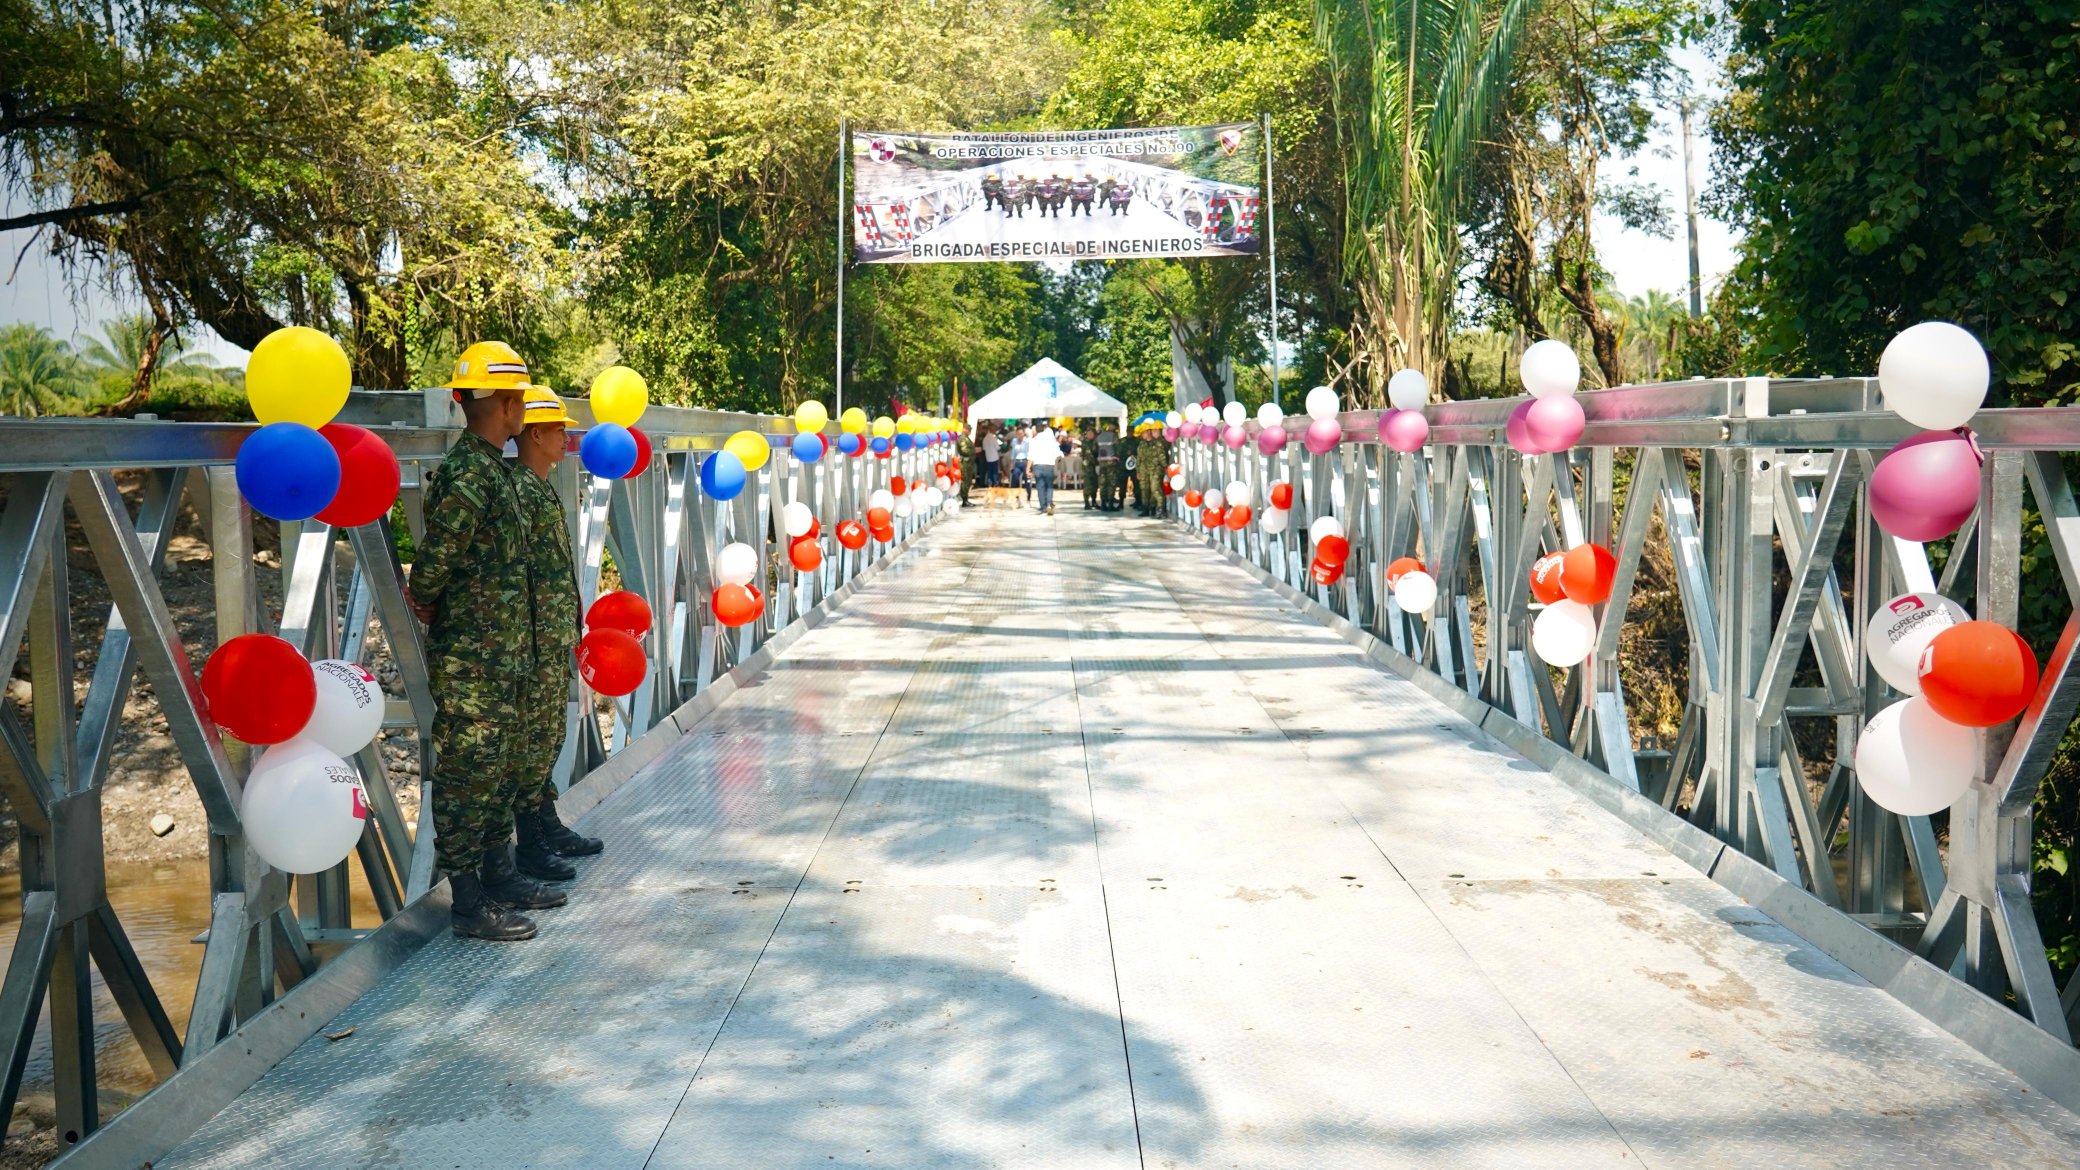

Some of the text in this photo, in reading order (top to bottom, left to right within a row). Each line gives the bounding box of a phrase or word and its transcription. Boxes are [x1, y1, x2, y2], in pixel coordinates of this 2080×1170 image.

[937, 142, 1195, 158] OPERACIONES ESPECIALES No. 90
[1036, 133, 1055, 143] DE
[1060, 129, 1153, 143] INGENIEROS
[912, 238, 1202, 257] BRIGADA ESPECIAL DE INGENIEROS
[1887, 609, 1952, 637] AGREGADOS
[1890, 616, 1956, 645] NACIONALES
[315, 665, 366, 709] NACIONALES
[321, 661, 372, 704] AGREGADOS
